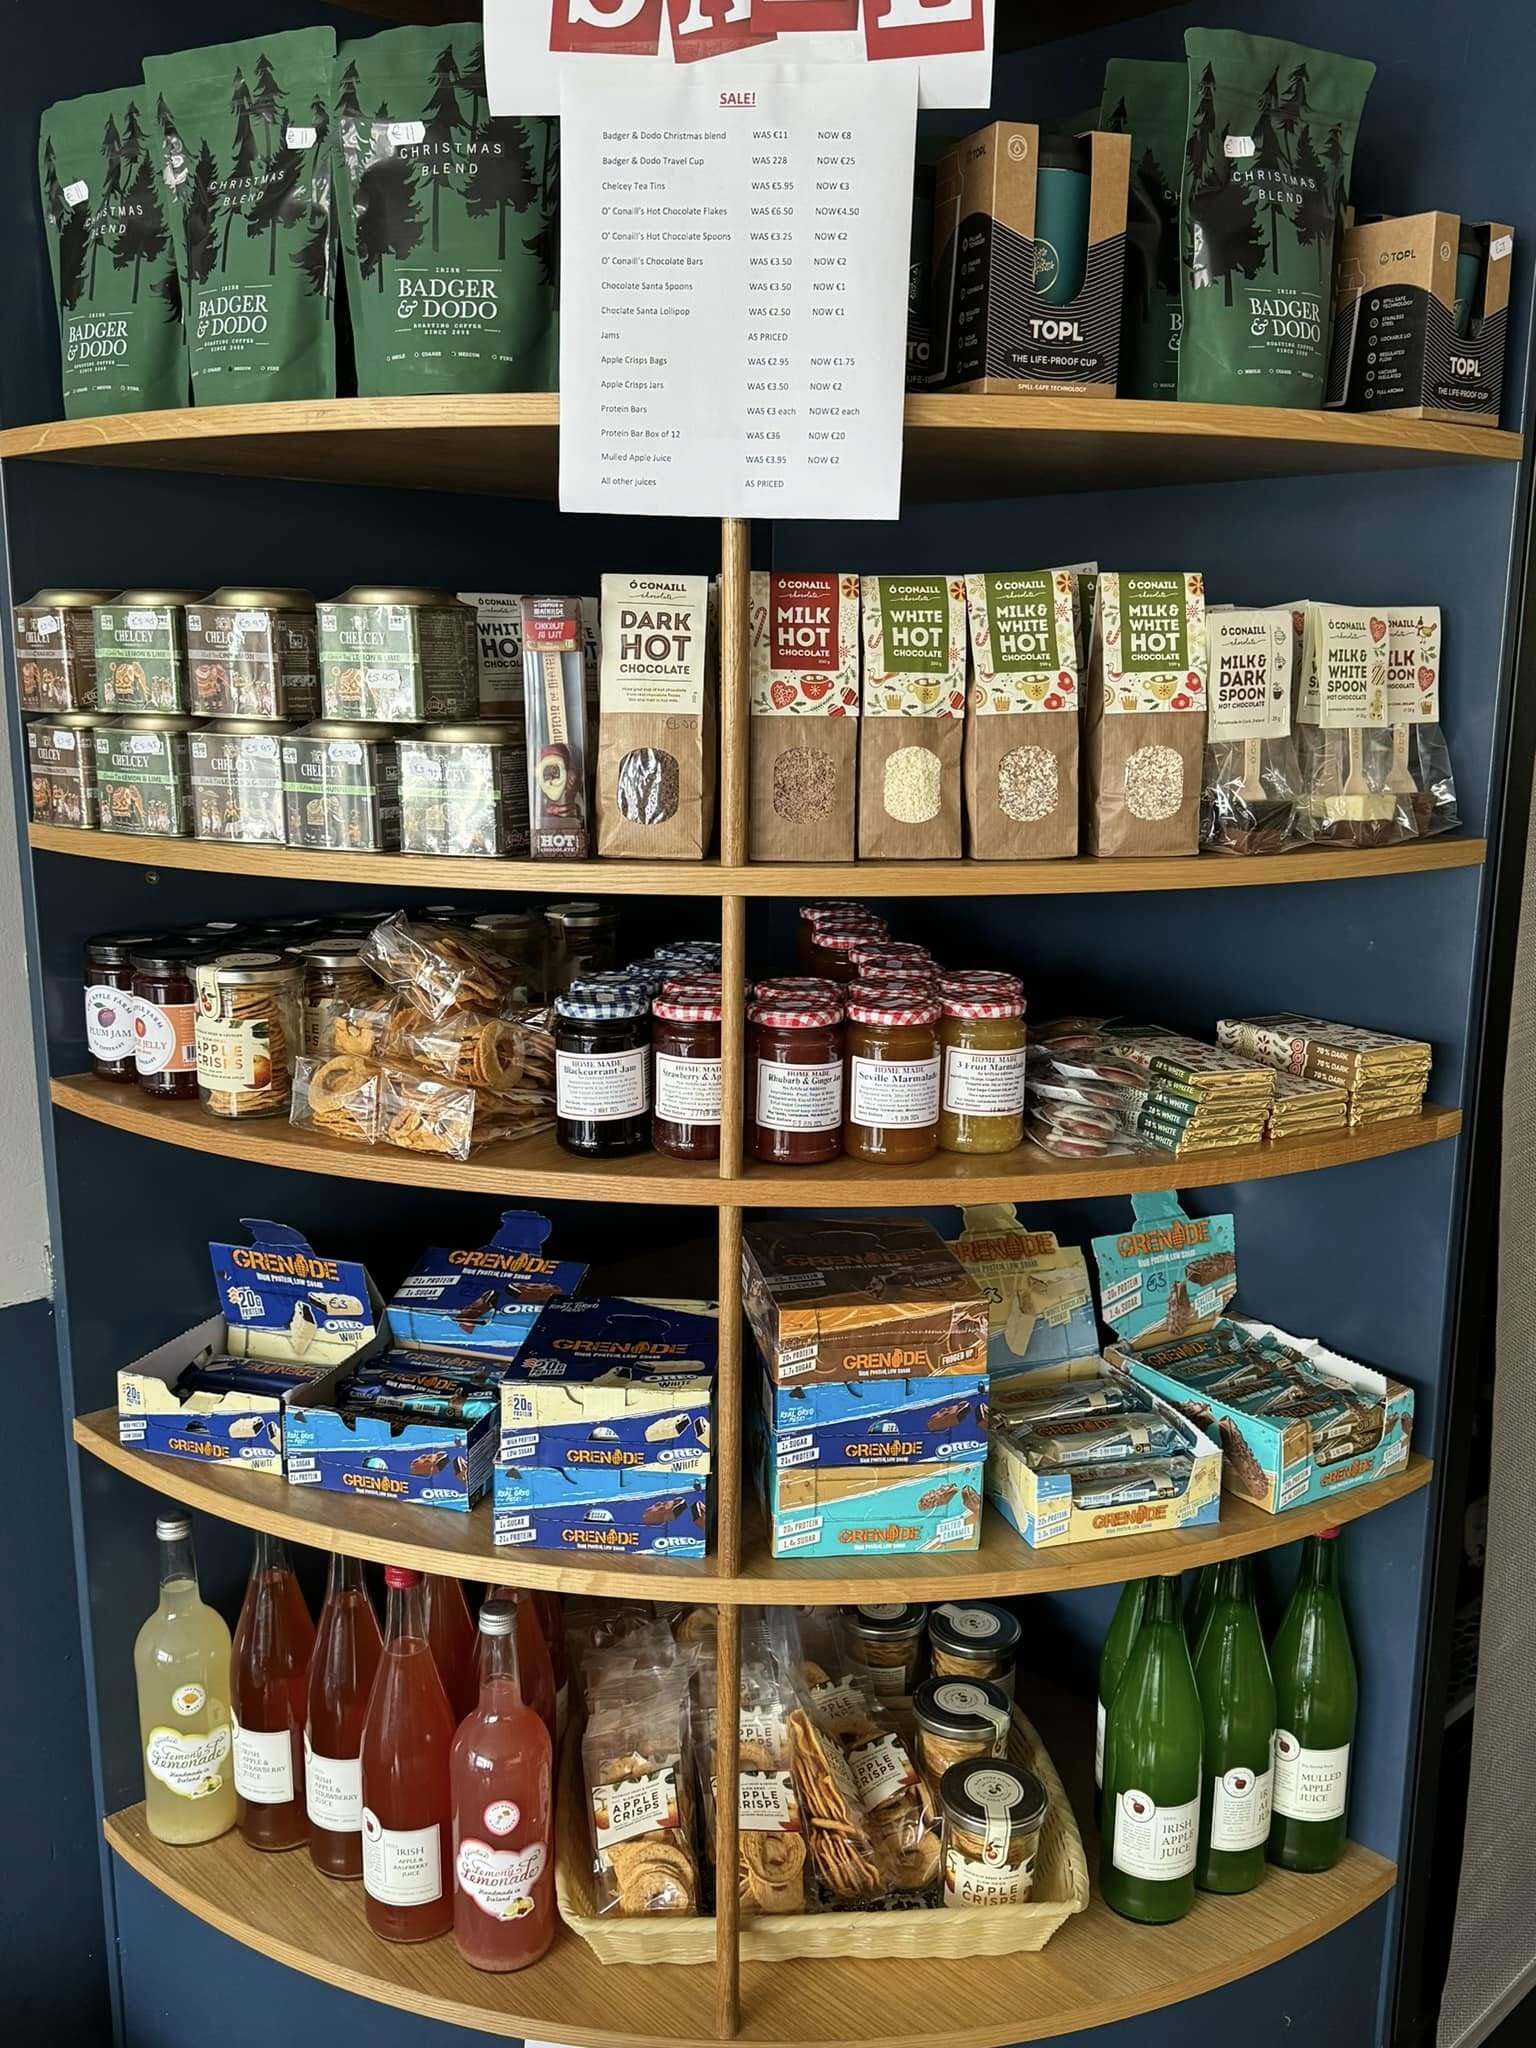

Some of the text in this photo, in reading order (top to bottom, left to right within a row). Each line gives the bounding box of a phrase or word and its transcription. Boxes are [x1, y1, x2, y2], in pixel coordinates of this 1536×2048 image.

[719, 92, 757, 105] SALE!
[602, 131, 631, 142] Badger
[640, 130, 663, 140] Dodo
[663, 131, 704, 141] Christmas
[703, 131, 726, 141] blend
[752, 130, 772, 140] WAS
[772, 130, 788, 140] €11
[816, 130, 839, 140] NOW
[840, 130, 853, 141] €8
[399, 143, 503, 160] CHRISTMAS
[601, 156, 630, 167] Badger
[639, 156, 662, 165] Dodo
[662, 156, 688, 166] Travel
[688, 156, 705, 167] Cup
[751, 156, 771, 165] WAS
[816, 156, 839, 165] NOW
[839, 156, 856, 166] €25
[420, 162, 479, 177] BLEND
[208, 169, 286, 192] CHRISTMAS
[633, 181, 649, 191] Tea
[649, 181, 666, 191] Tins
[751, 181, 771, 191] WAS
[771, 181, 795, 191] €5.95
[815, 181, 839, 191] NOW
[839, 181, 850, 191] €3
[1233, 170, 1316, 190] CHRISTMAS
[223, 190, 264, 207] BLEND
[1258, 190, 1304, 205] BLEND
[1390, 249, 1416, 263] TOPL
[397, 278, 499, 299] BADGER
[198, 293, 269, 320] BADGER
[397, 300, 498, 320] & DODO
[635, 306, 658, 316] Santa
[659, 306, 691, 317] Lollipop
[748, 307, 768, 317] WAS
[768, 307, 792, 317] €2.50
[811, 307, 834, 317] NOW
[834, 307, 845, 317] €1
[1248, 297, 1322, 323] BADGER
[68, 319, 128, 344] BADGER
[196, 314, 267, 340] & DODO
[1029, 319, 1084, 342] TOPL
[1250, 318, 1322, 344] & DODO
[600, 331, 789, 342] Jams AS PRICED
[67, 338, 128, 361] & DODO
[1012, 354, 1098, 367] THE LIFE-PROOF CUP
[1450, 357, 1482, 378] TOPL
[600, 428, 630, 438] Protein
[630, 429, 644, 438] Bar
[644, 429, 660, 438] Box
[660, 429, 670, 438] of
[671, 430, 681, 439] 12
[745, 431, 765, 440] WAS
[808, 431, 830, 441] NOW
[830, 431, 846, 441] €20
[600, 476, 785, 489] All other juices AS PRICED
[639, 581, 687, 592] CONAILL
[787, 580, 831, 590] CONAILL
[777, 606, 832, 624] MILK
[889, 609, 943, 624] WHITE
[996, 603, 1048, 619] MILK &
[619, 610, 692, 631] DARK
[996, 618, 1049, 633] WHITE
[114, 629, 154, 643] CHELCEY
[777, 627, 831, 648] HOT
[892, 627, 944, 648] HOT
[1228, 625, 1267, 636] CONAILL
[339, 631, 387, 646] CHELCEY
[999, 632, 1049, 653] HOT
[619, 634, 692, 661] HOT
[778, 648, 831, 658] CHOCOLATE
[893, 649, 943, 658] CHOCOLATE
[1001, 653, 1051, 662] CHOCOLATE
[1220, 654, 1267, 671] MILK &
[619, 664, 690, 675] CHOCOLATE
[1328, 665, 1367, 679] WHITE
[1219, 669, 1267, 687] DARK
[1327, 680, 1367, 693] SPOON
[1218, 687, 1266, 702] SPOON
[1218, 700, 1265, 710] HOT CHOCOLATE
[111, 753, 150, 768] CHELCEY
[110, 1029, 132, 1040] JAM
[142, 1038, 167, 1050] JELLY
[563, 1063, 637, 1077] Blackcurrant Jam
[768, 1073, 832, 1087] Rhubarb & Ginger
[858, 1072, 890, 1084] Seville
[241, 1307, 264, 1317] PROTEIN
[324, 1320, 364, 1332] OREO
[339, 1330, 363, 1343] WHITE
[942, 1353, 966, 1367] FUDGED
[239, 1446, 276, 1458] OREO
[657, 1448, 702, 1464] OREO
[936, 1440, 980, 1457] OREO
[251, 1458, 273, 1469] WHITE
[1301, 1771, 1342, 1783] MULLED
[1299, 1783, 1332, 1793] APPLE
[612, 1790, 660, 1815] APPLE
[1299, 1792, 1328, 1803] JUICE
[612, 1801, 660, 1824] CRISPS
[1162, 1818, 1193, 1835] IRISH
[1161, 1828, 1194, 1847] APPLE
[396, 1846, 425, 1856] IRISH
[1160, 1841, 1191, 1860] JUICE
[963, 1880, 1018, 1895] APPLE
